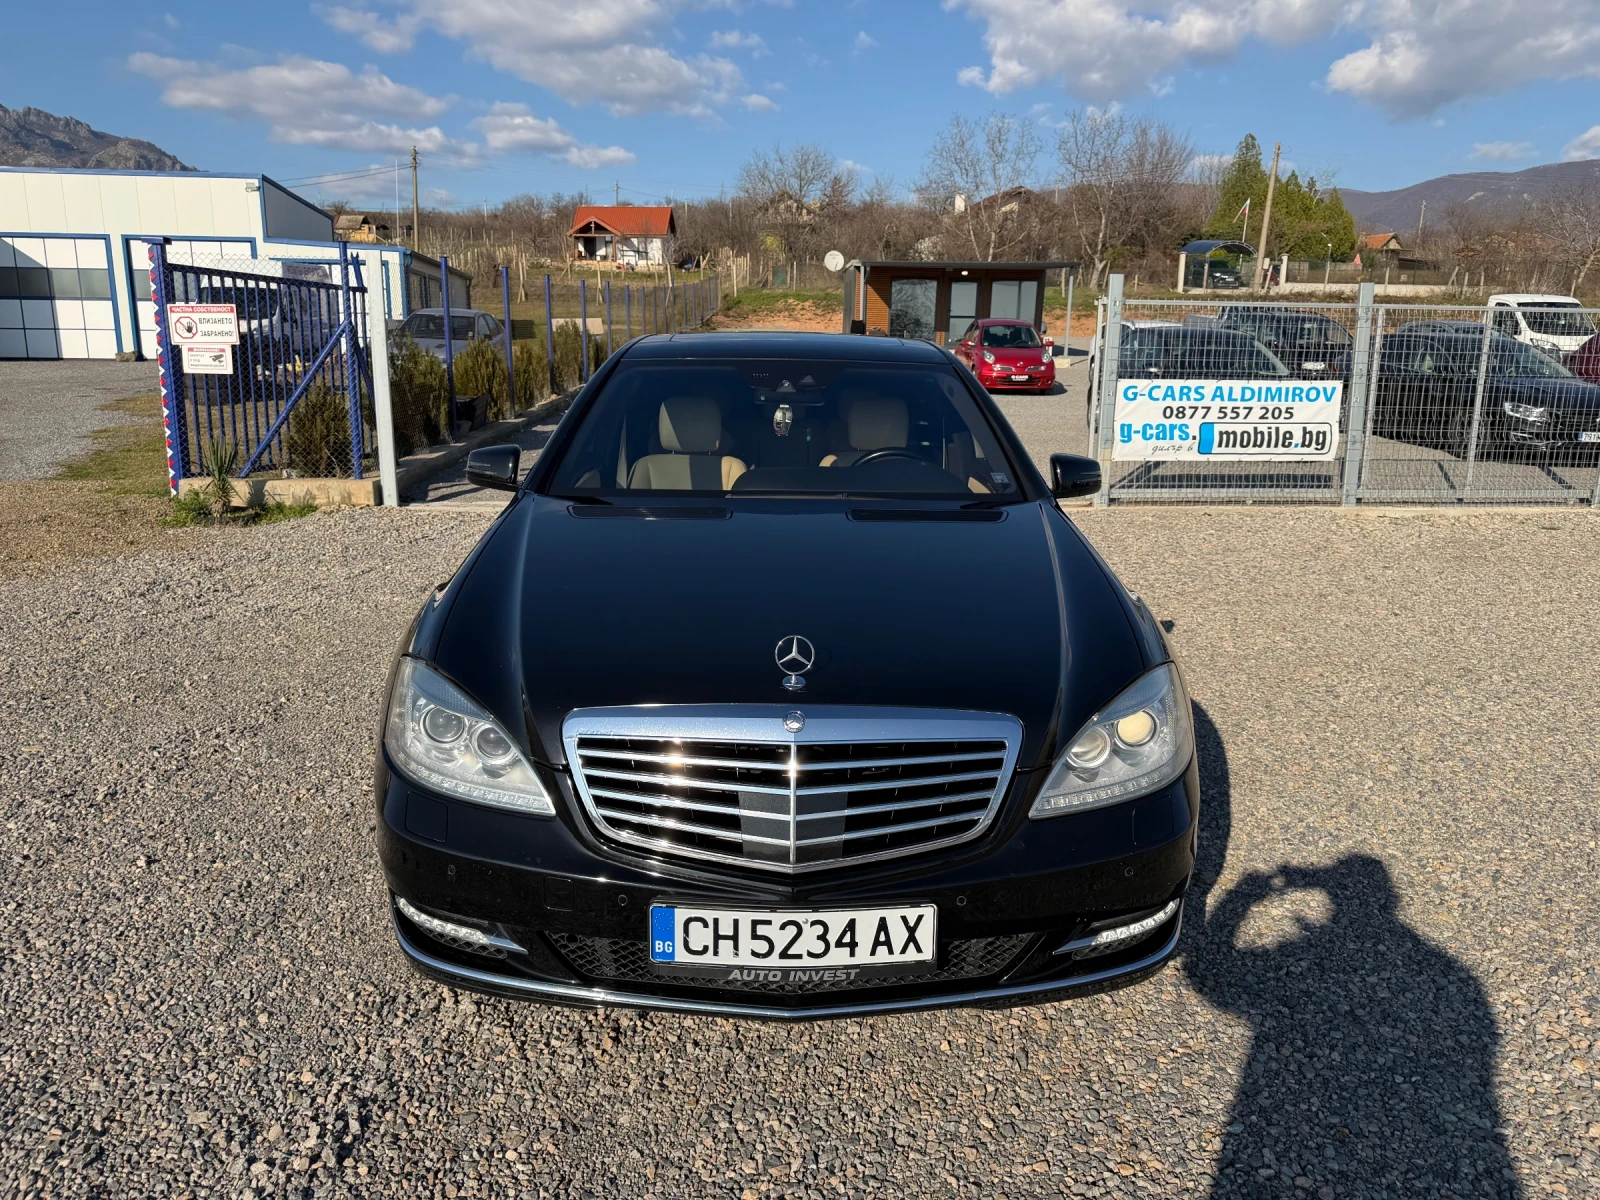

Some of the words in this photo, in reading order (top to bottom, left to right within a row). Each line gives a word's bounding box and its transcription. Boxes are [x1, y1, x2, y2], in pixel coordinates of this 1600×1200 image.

[198, 317, 233, 325] ВЛИЗАНЕТО
[1122, 385, 1205, 402] G-CARS
[1210, 386, 1337, 403] ALDIMIROV
[1162, 405, 1212, 420] 0877
[1217, 406, 1254, 420] 557
[1258, 406, 1295, 420] 205
[1217, 426, 1328, 451] mobile.bg
[655, 940, 673, 954] BG
[728, 969, 782, 982] AUTO
[789, 968, 860, 981] INVEST
